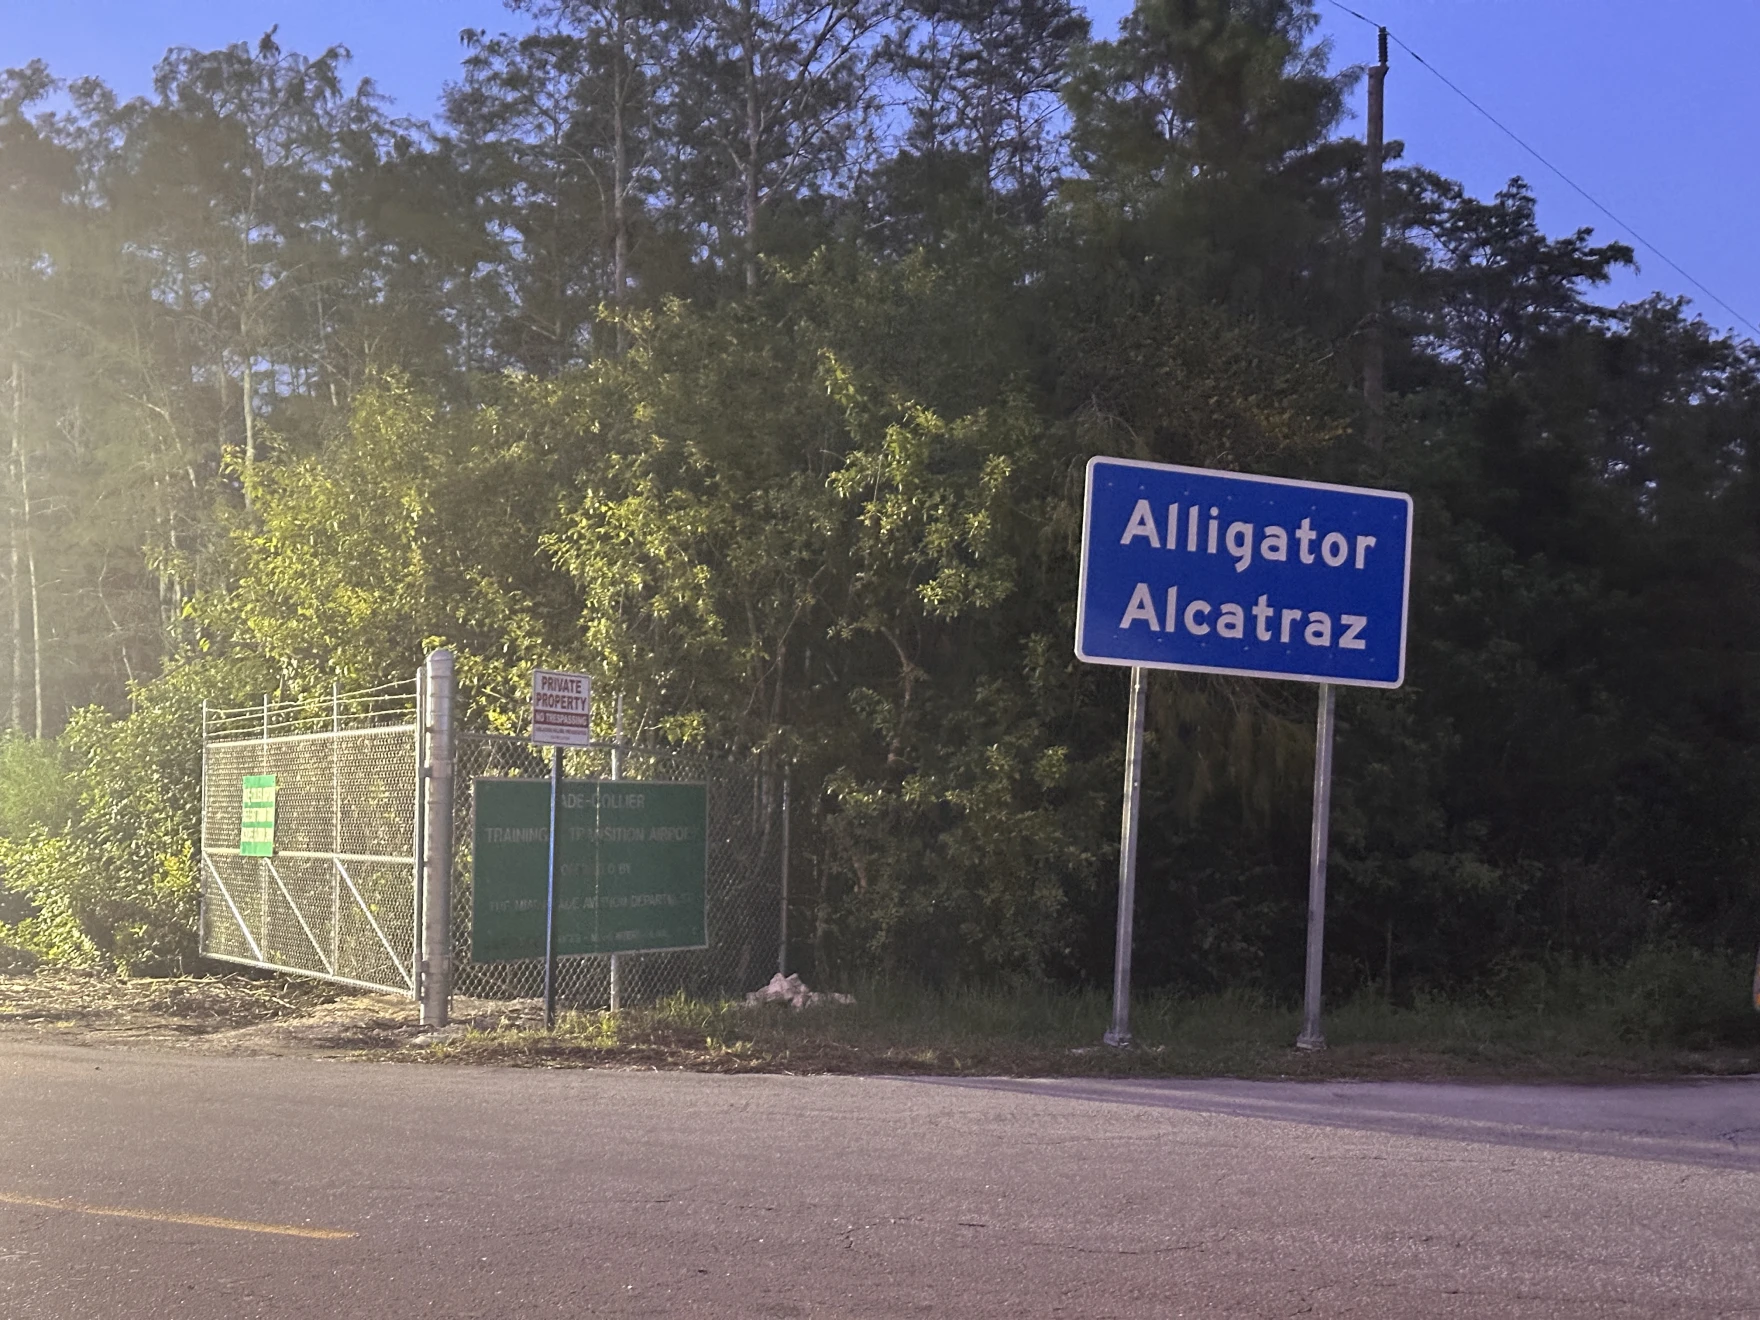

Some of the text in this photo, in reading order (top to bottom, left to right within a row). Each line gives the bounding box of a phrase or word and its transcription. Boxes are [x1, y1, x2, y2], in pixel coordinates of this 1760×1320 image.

[1119, 499, 1377, 573] Alligator
[1119, 582, 1367, 650] Alcatraz
[541, 676, 582, 694] PRIVATE
[536, 693, 587, 711] PROPERTY
[535, 712, 587, 725] NO TRESPASSING
[561, 794, 645, 809] ADE-COLLIER
[485, 827, 550, 843] TRAINING
